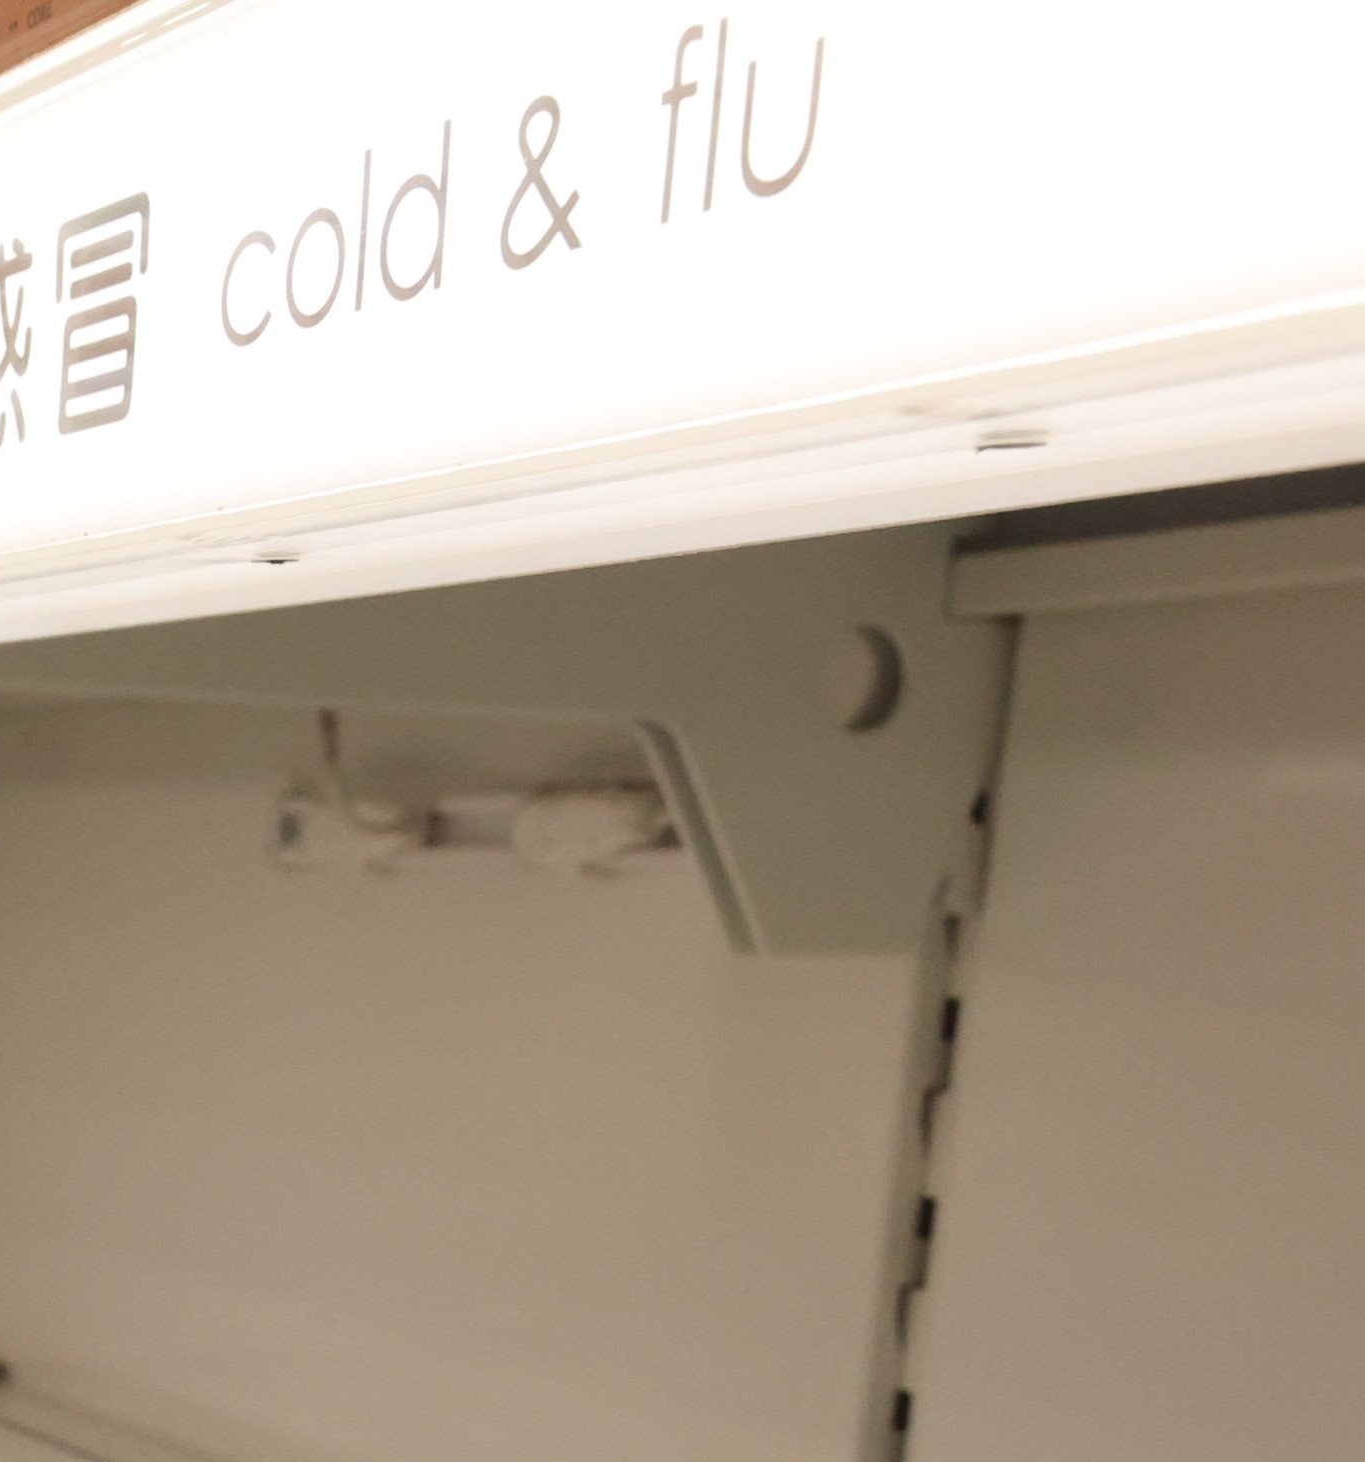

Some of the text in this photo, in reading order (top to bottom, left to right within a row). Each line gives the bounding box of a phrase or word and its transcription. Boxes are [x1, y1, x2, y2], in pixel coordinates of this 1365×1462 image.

[220, 17, 826, 348] cold & flu
